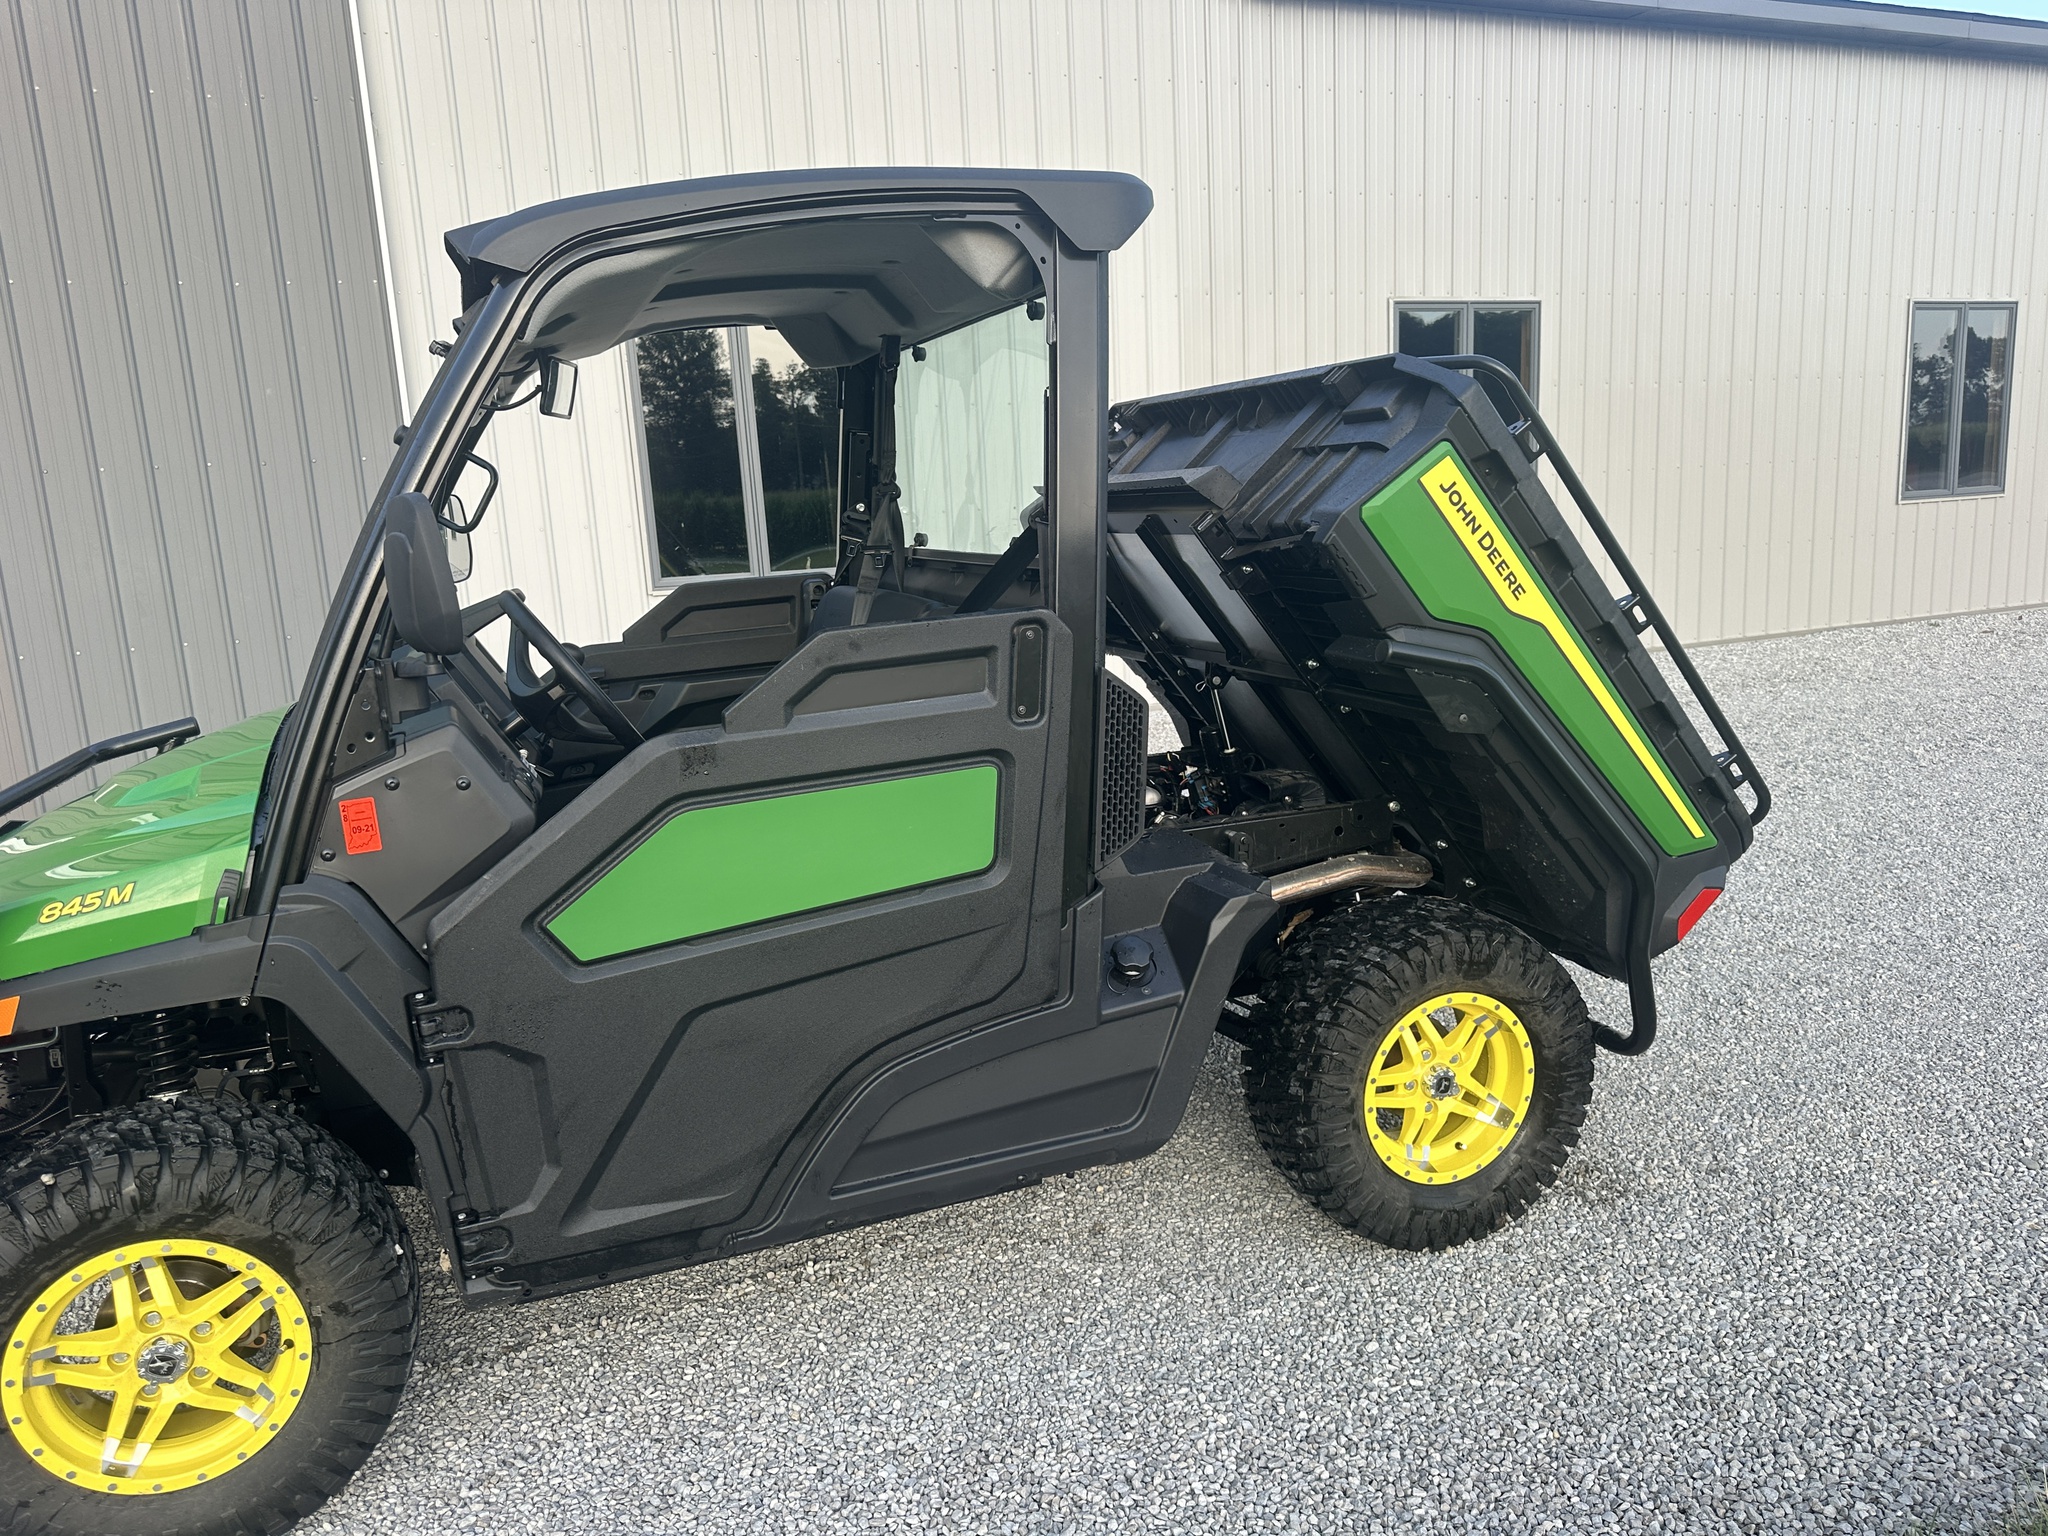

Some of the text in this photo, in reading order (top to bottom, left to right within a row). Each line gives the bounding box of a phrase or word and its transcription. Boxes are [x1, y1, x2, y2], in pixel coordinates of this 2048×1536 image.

[1439, 481, 1527, 601] JOHN DEERE
[352, 824, 374, 834] 09-21
